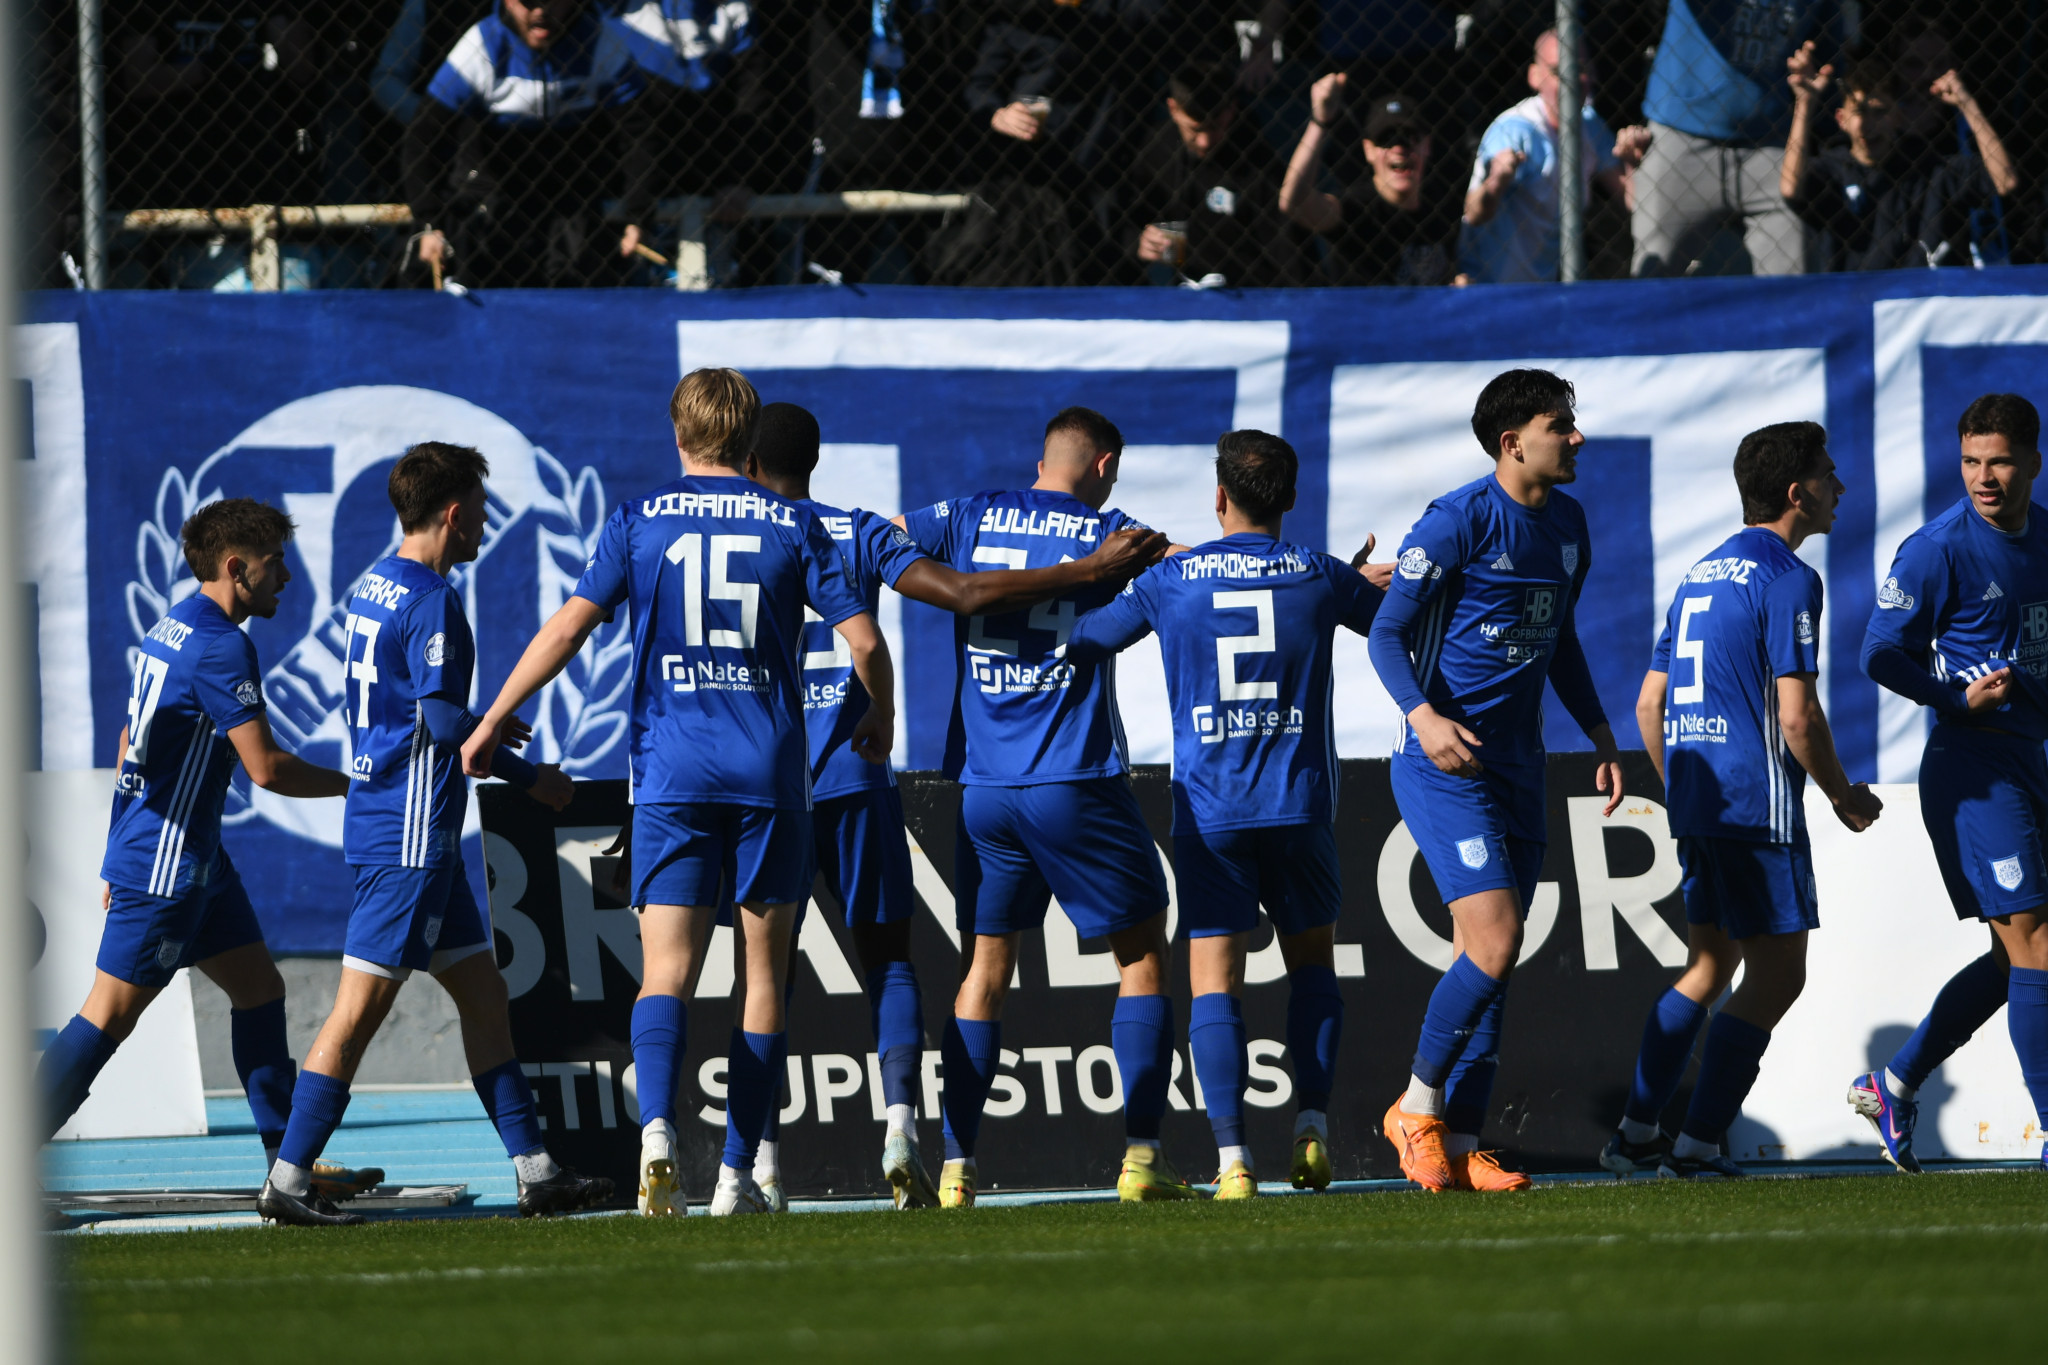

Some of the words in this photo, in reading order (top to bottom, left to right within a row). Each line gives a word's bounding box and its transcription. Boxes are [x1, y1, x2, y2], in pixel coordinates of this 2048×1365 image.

[643, 492, 796, 527] VIRAMÄKI
[665, 533, 762, 649] 15
[1213, 589, 1278, 701] 2
[1674, 595, 1712, 705] 5
[697, 660, 770, 683] Natech
[1005, 663, 1076, 684] Natech
[732, 683, 770, 692] SOLUTONS
[1005, 684, 1036, 693] BANKING
[1227, 705, 1303, 729] Natech
[1228, 729, 1261, 738] BANKING
[1262, 726, 1303, 736] SOLUTIONS
